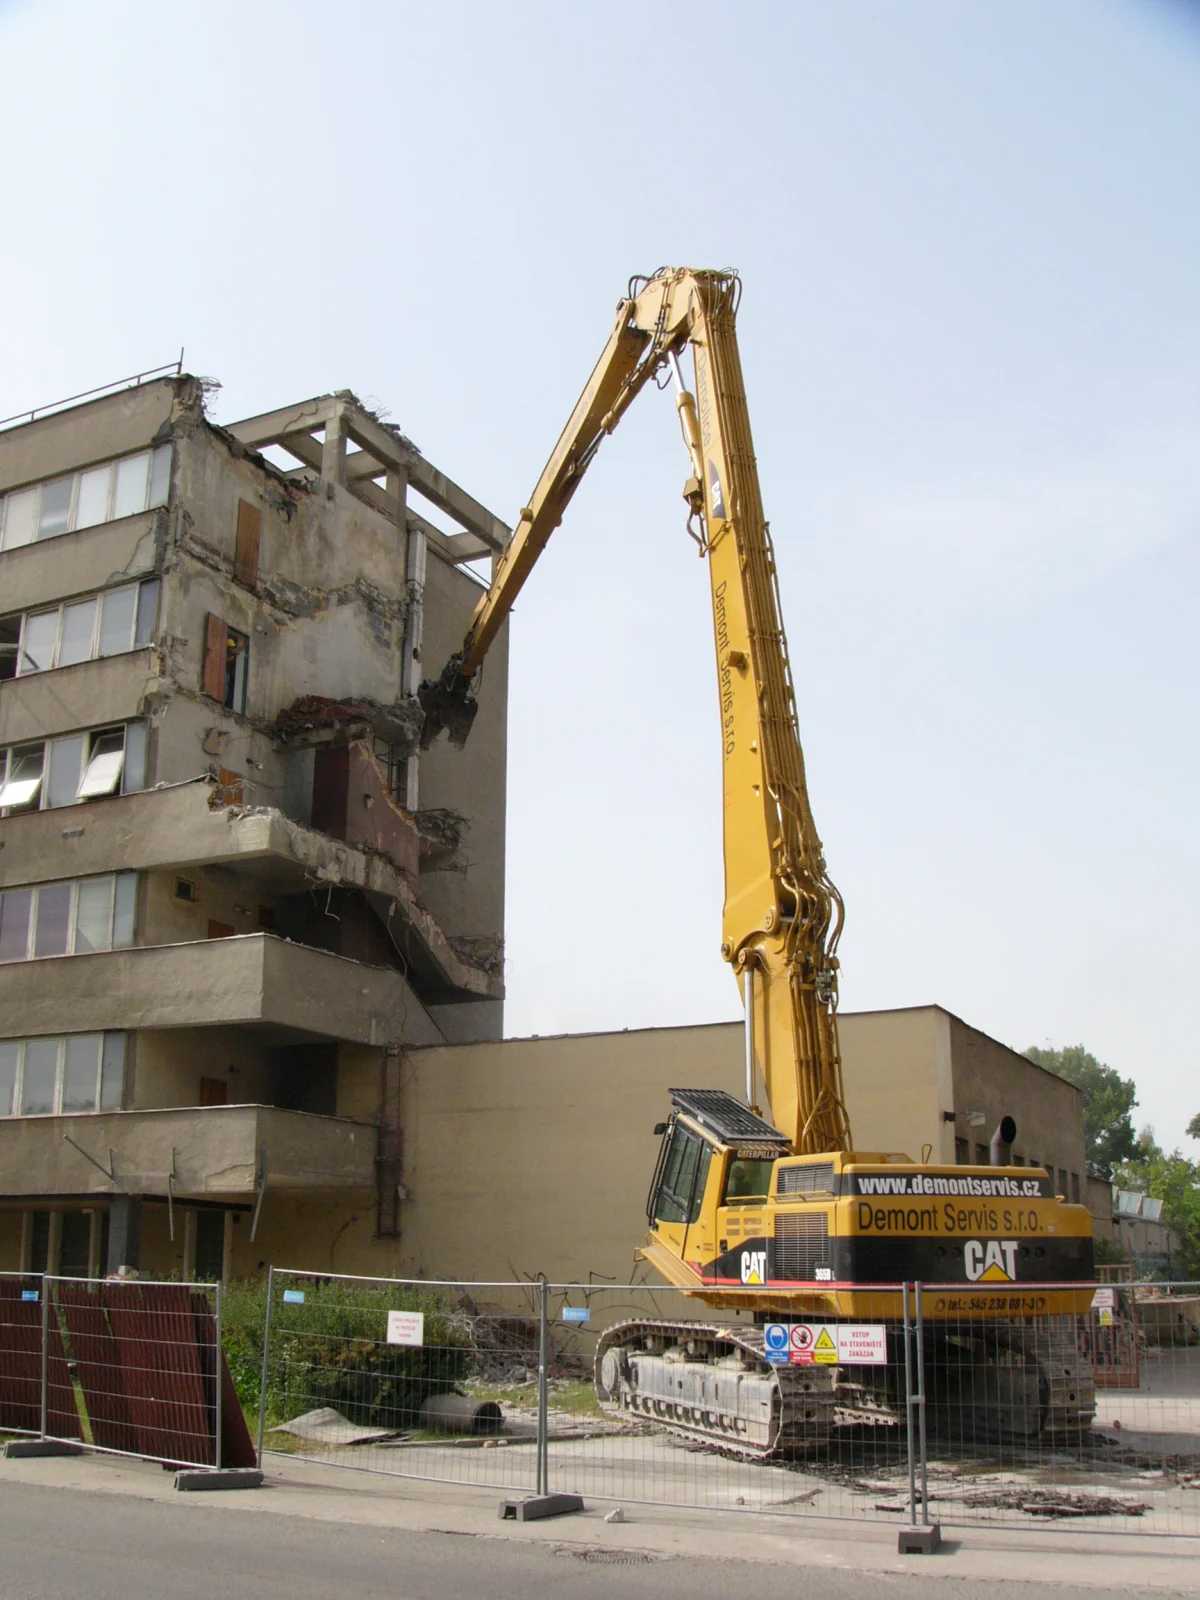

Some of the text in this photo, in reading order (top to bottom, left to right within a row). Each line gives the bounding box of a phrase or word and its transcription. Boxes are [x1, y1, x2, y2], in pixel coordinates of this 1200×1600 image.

[697, 351, 712, 448] Demolice
[711, 480, 722, 510] CAT
[715, 580, 730, 653] Demont
[724, 714, 736, 761] s.r.o.
[737, 1150, 780, 1159] CATERPILLAR
[858, 1174, 1041, 1197] www.demontservis.cz
[858, 1202, 1044, 1232] Demont Servis s.r.o.
[741, 1251, 766, 1285] CAT
[815, 1268, 832, 1281] 365B
[964, 1239, 1019, 1281] CAT
